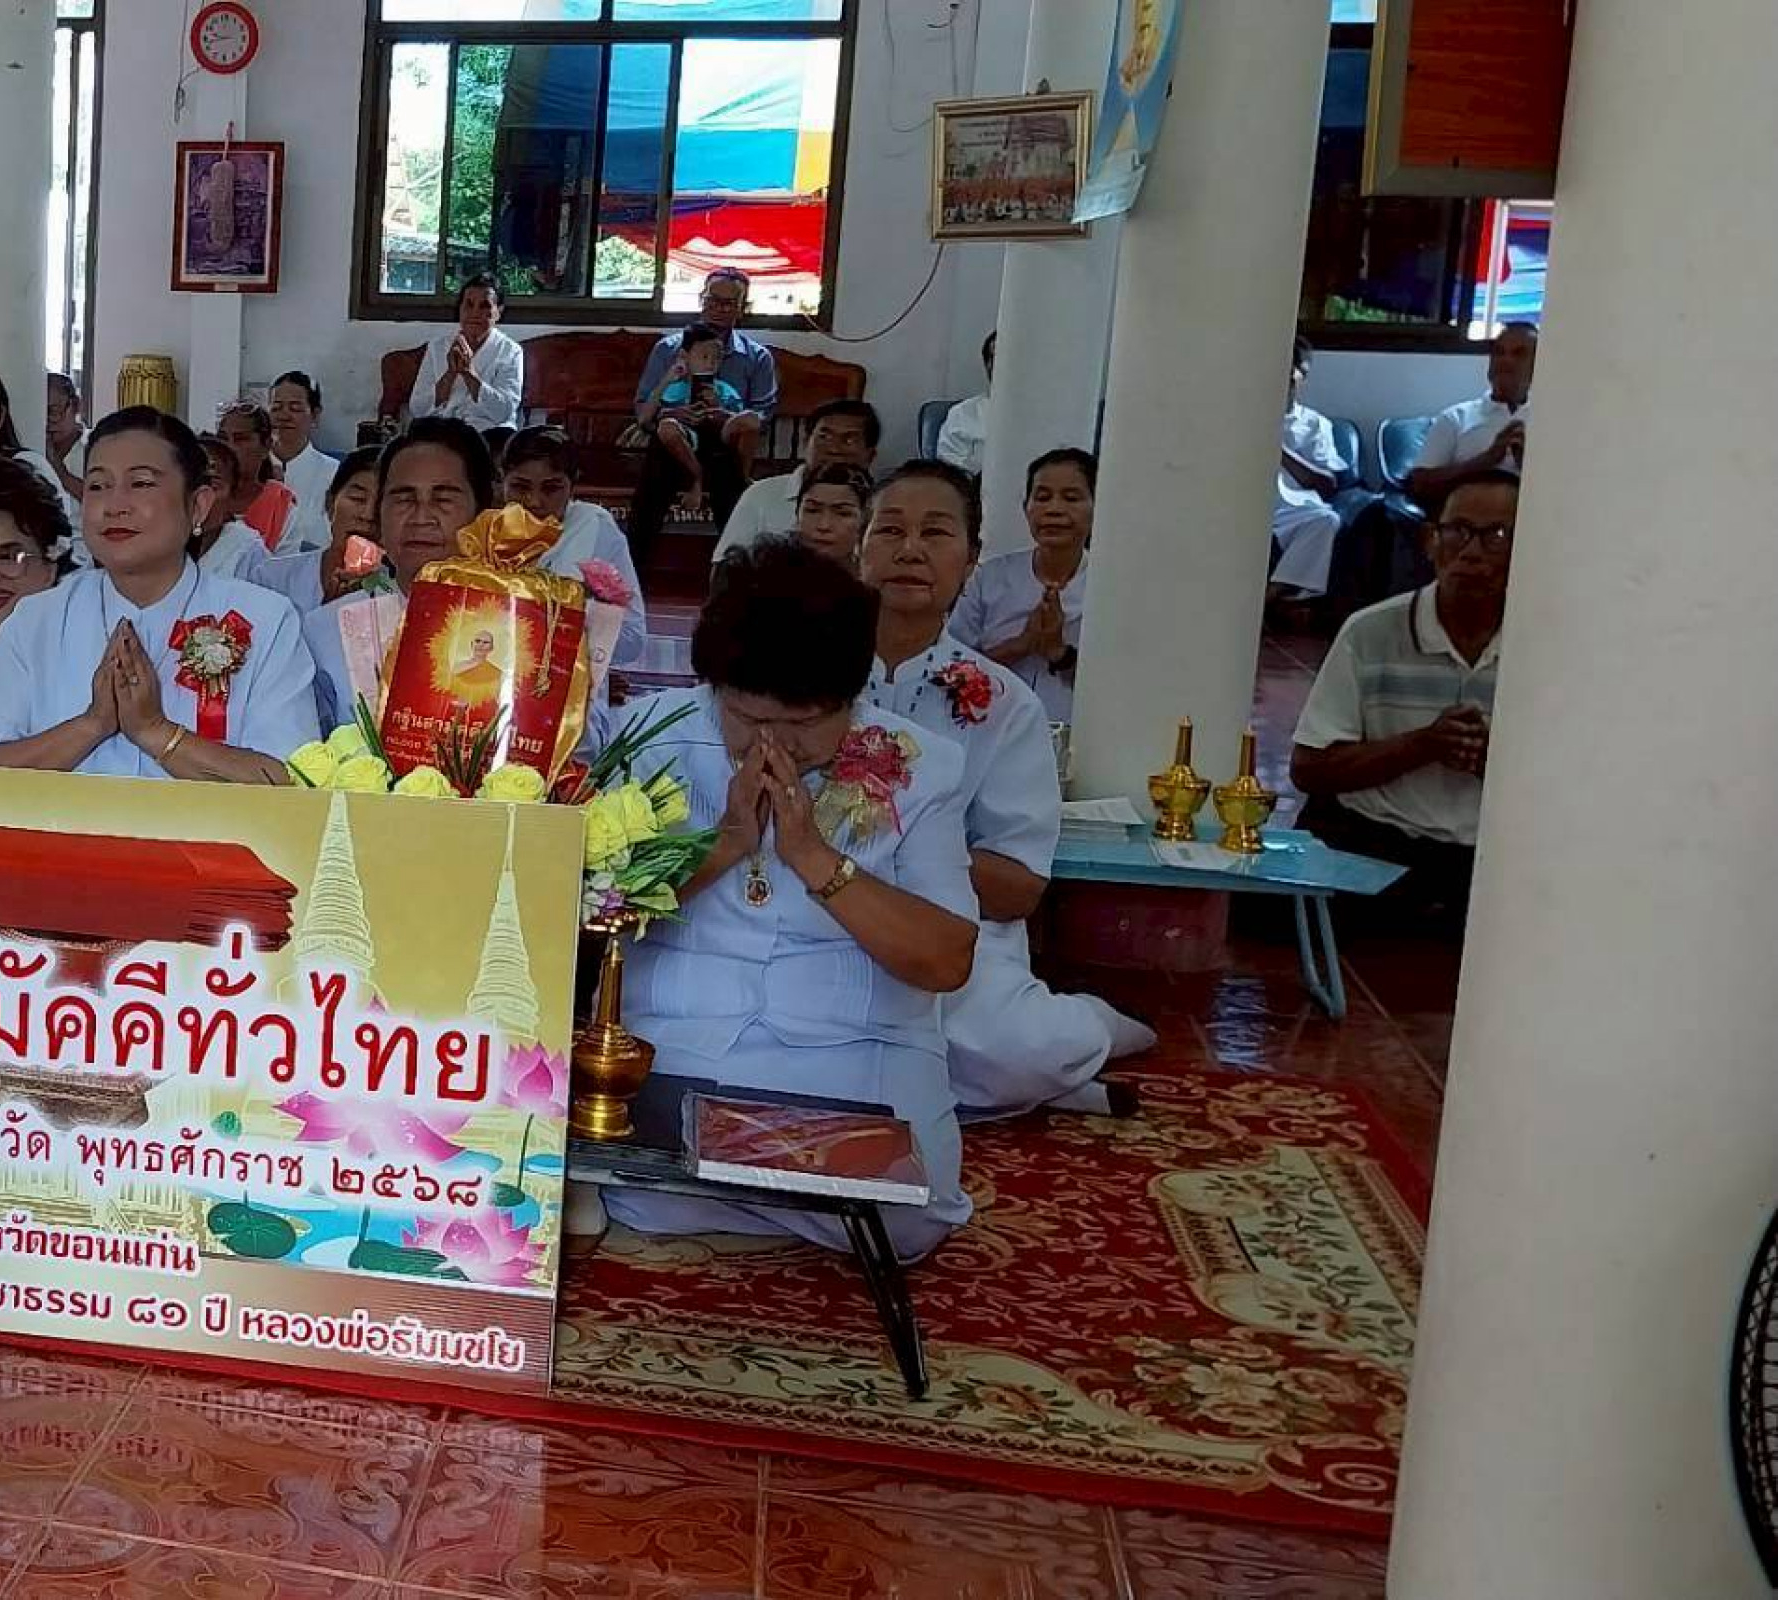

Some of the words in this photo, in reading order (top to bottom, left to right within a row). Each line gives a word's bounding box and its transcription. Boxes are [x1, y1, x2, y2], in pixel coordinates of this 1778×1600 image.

[0, 1109, 52, 1162] วัด
[77, 1127, 304, 1187] พุทธศักราช
[330, 1155, 484, 1208] ๒๕๖๘
[127, 1297, 189, 1328] ๘๑
[204, 1296, 228, 1333] ปี
[242, 1309, 520, 1368] หลวงพ่อธัมมชโย
